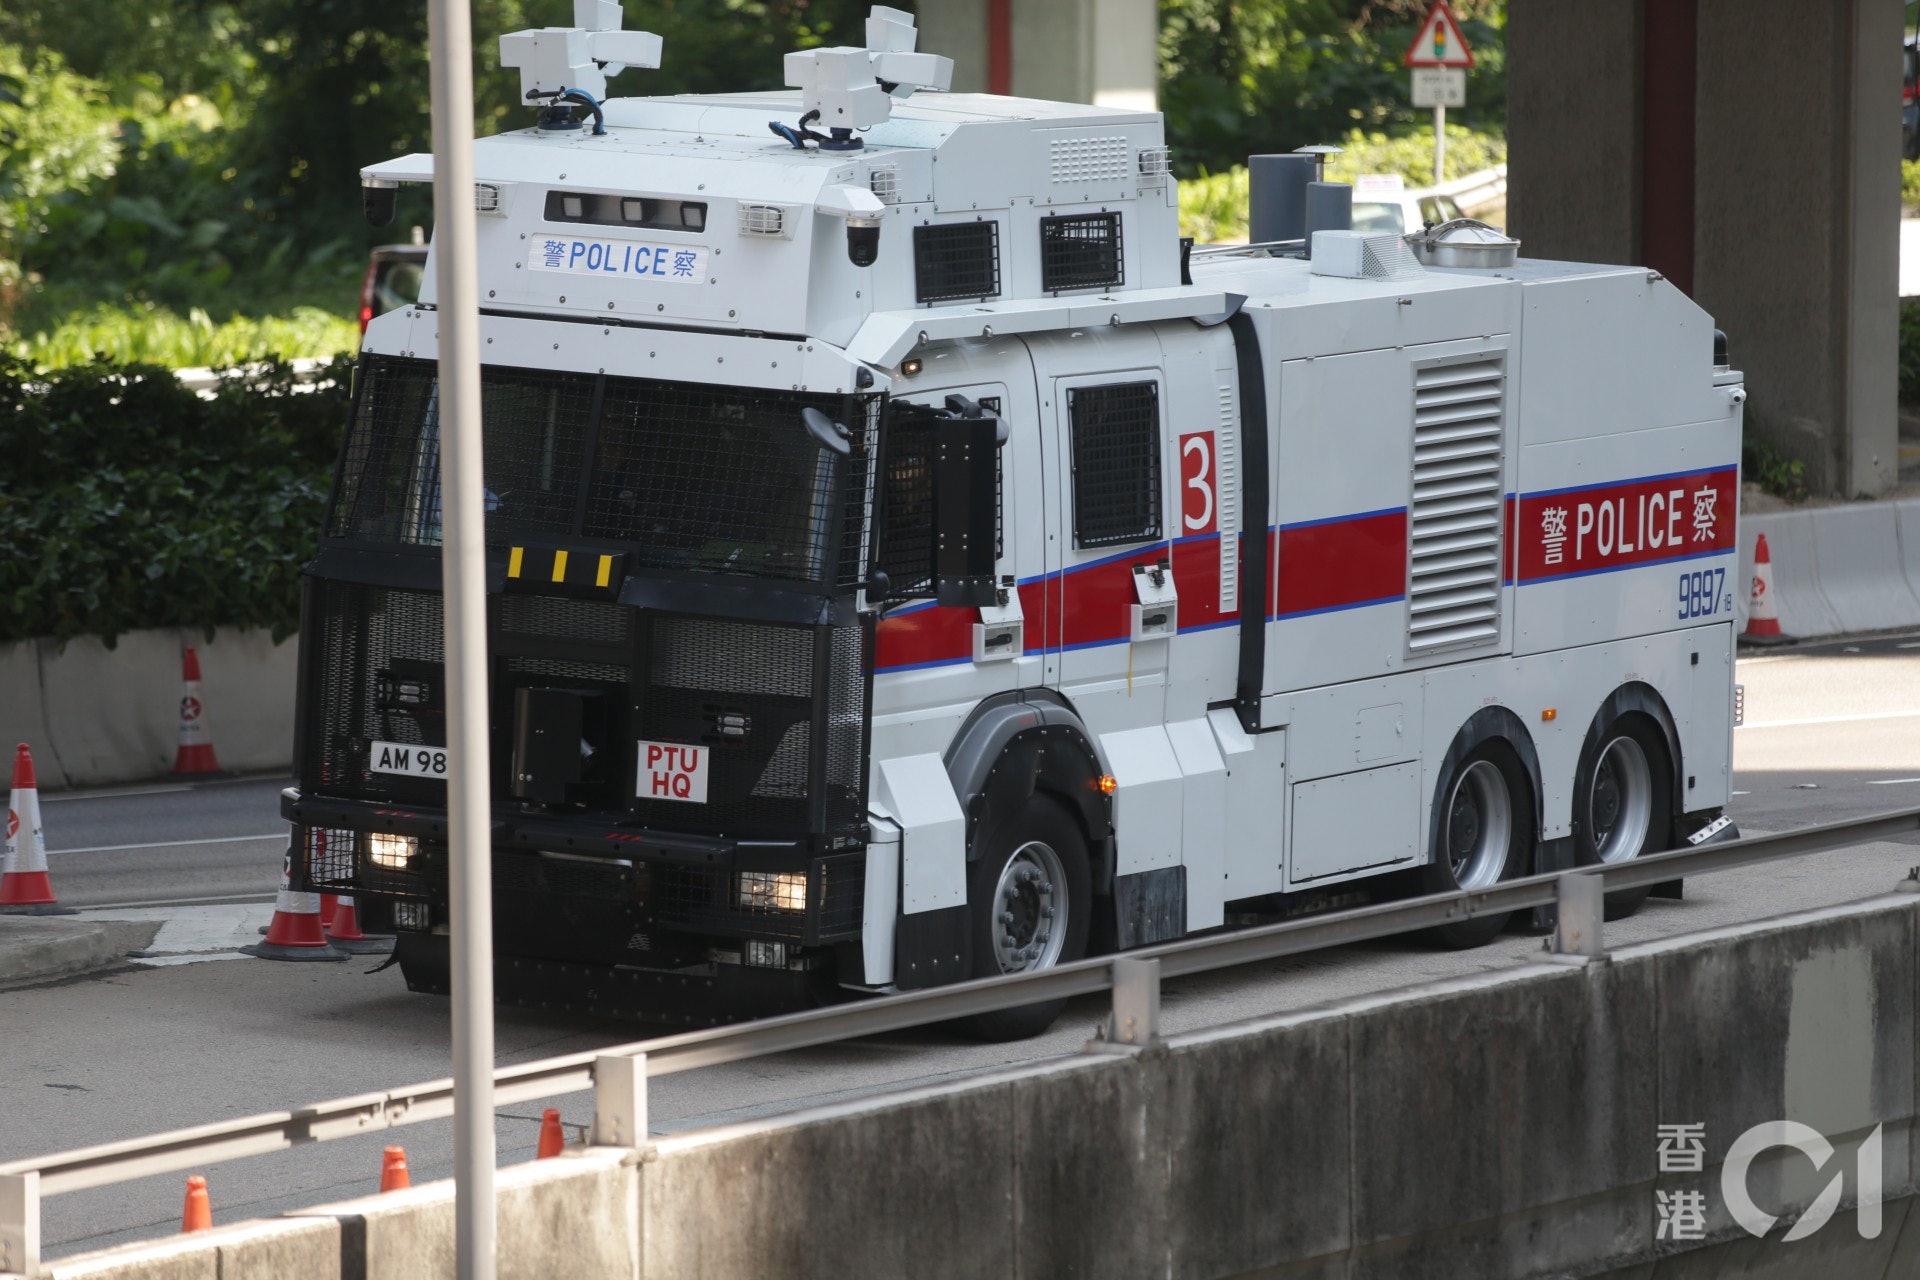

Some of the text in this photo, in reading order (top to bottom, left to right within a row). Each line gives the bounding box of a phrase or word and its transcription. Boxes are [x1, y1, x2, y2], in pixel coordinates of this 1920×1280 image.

[543, 240, 696, 277] 警 POLICE 察
[1183, 437, 1213, 530] 3
[1541, 485, 1717, 565] 警 POLICE 察
[1678, 568, 1725, 620] 9897
[379, 747, 409, 770] AM
[647, 745, 698, 772] PTU
[652, 771, 691, 798] HQ
